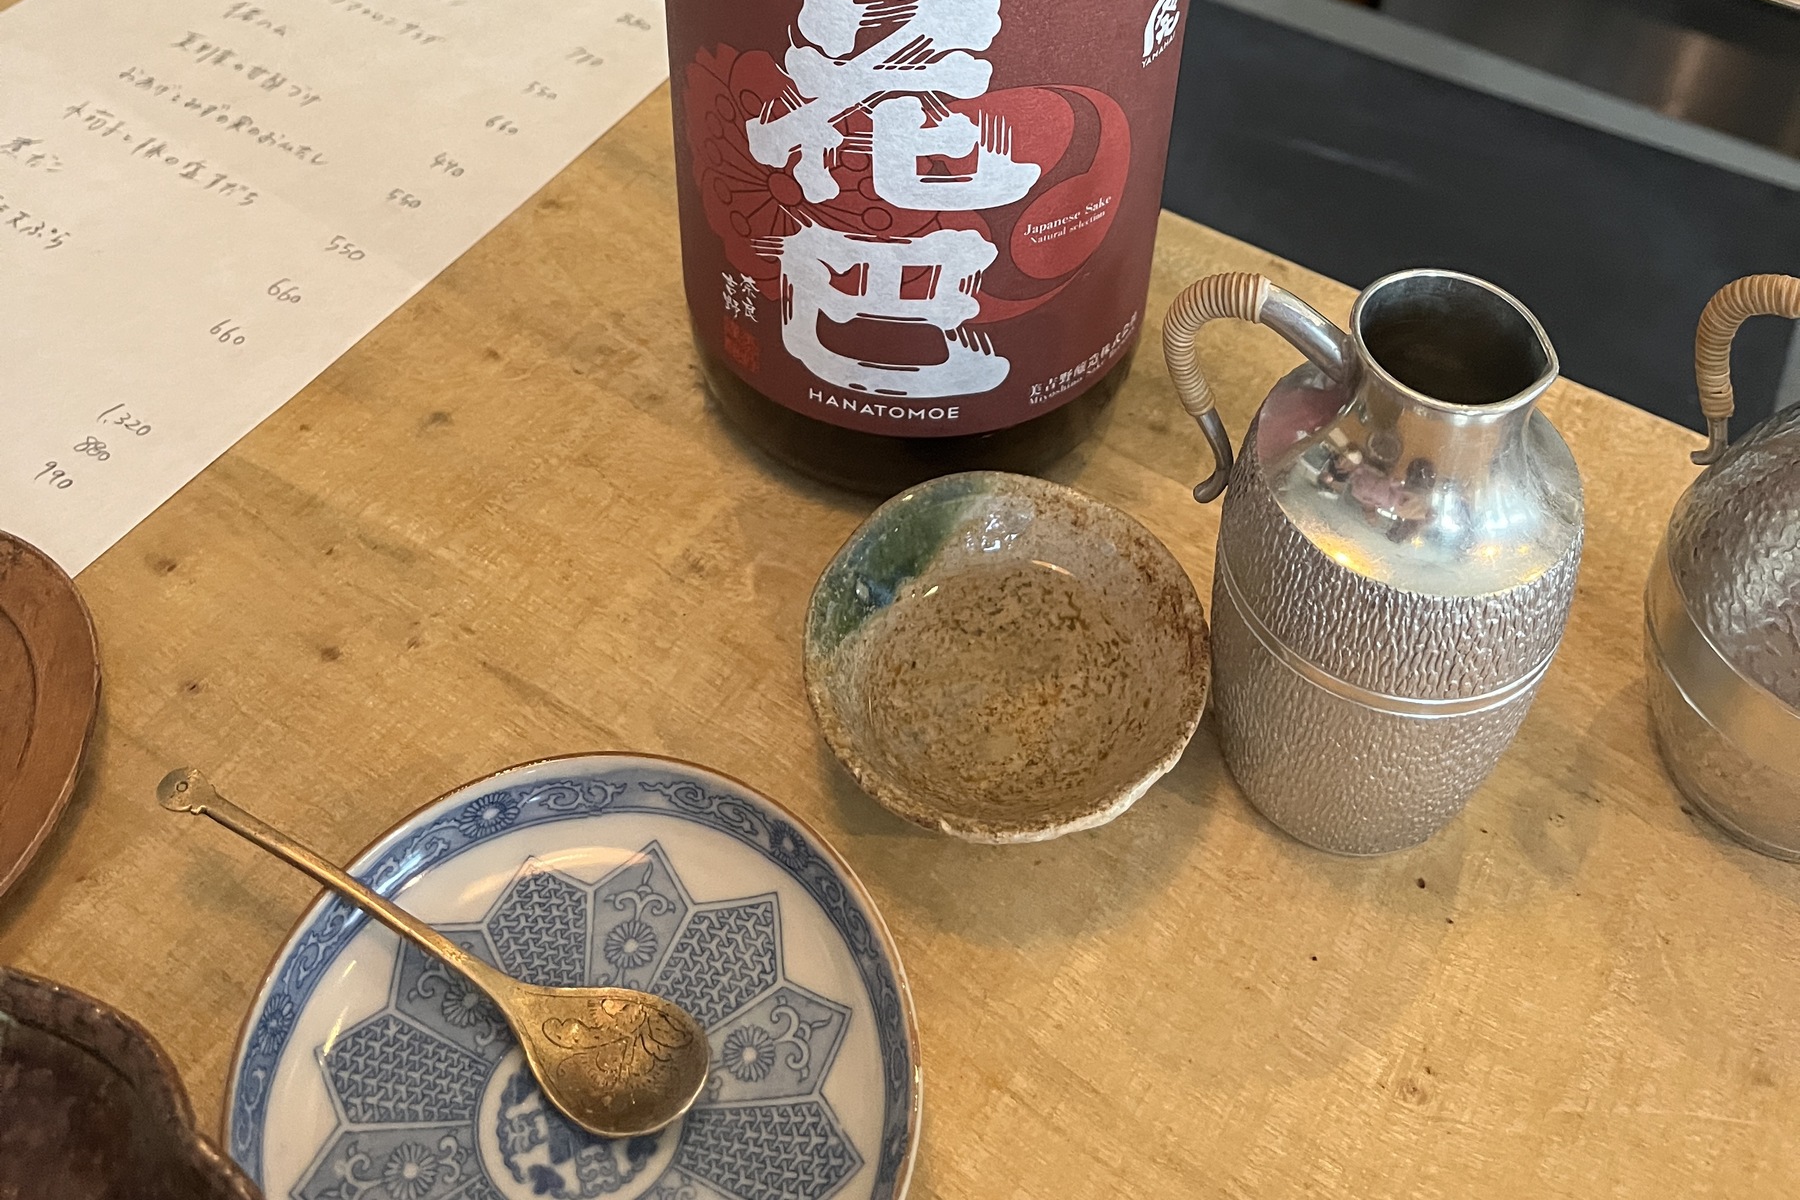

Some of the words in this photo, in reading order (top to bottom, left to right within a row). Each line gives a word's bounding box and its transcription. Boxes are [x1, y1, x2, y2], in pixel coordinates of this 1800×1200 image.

[386, 187, 422, 209] 550
[1023, 211, 1081, 236] Japanese
[1084, 196, 1112, 214] Sake
[1030, 227, 1066, 244] Natural
[1069, 210, 1106, 233] selection
[324, 235, 367, 262] 550
[267, 278, 302, 304] 660
[209, 319, 246, 346] 660
[808, 387, 960, 420] HANATOMOE
[73, 436, 111, 461] 880
[34, 461, 74, 490] 990
